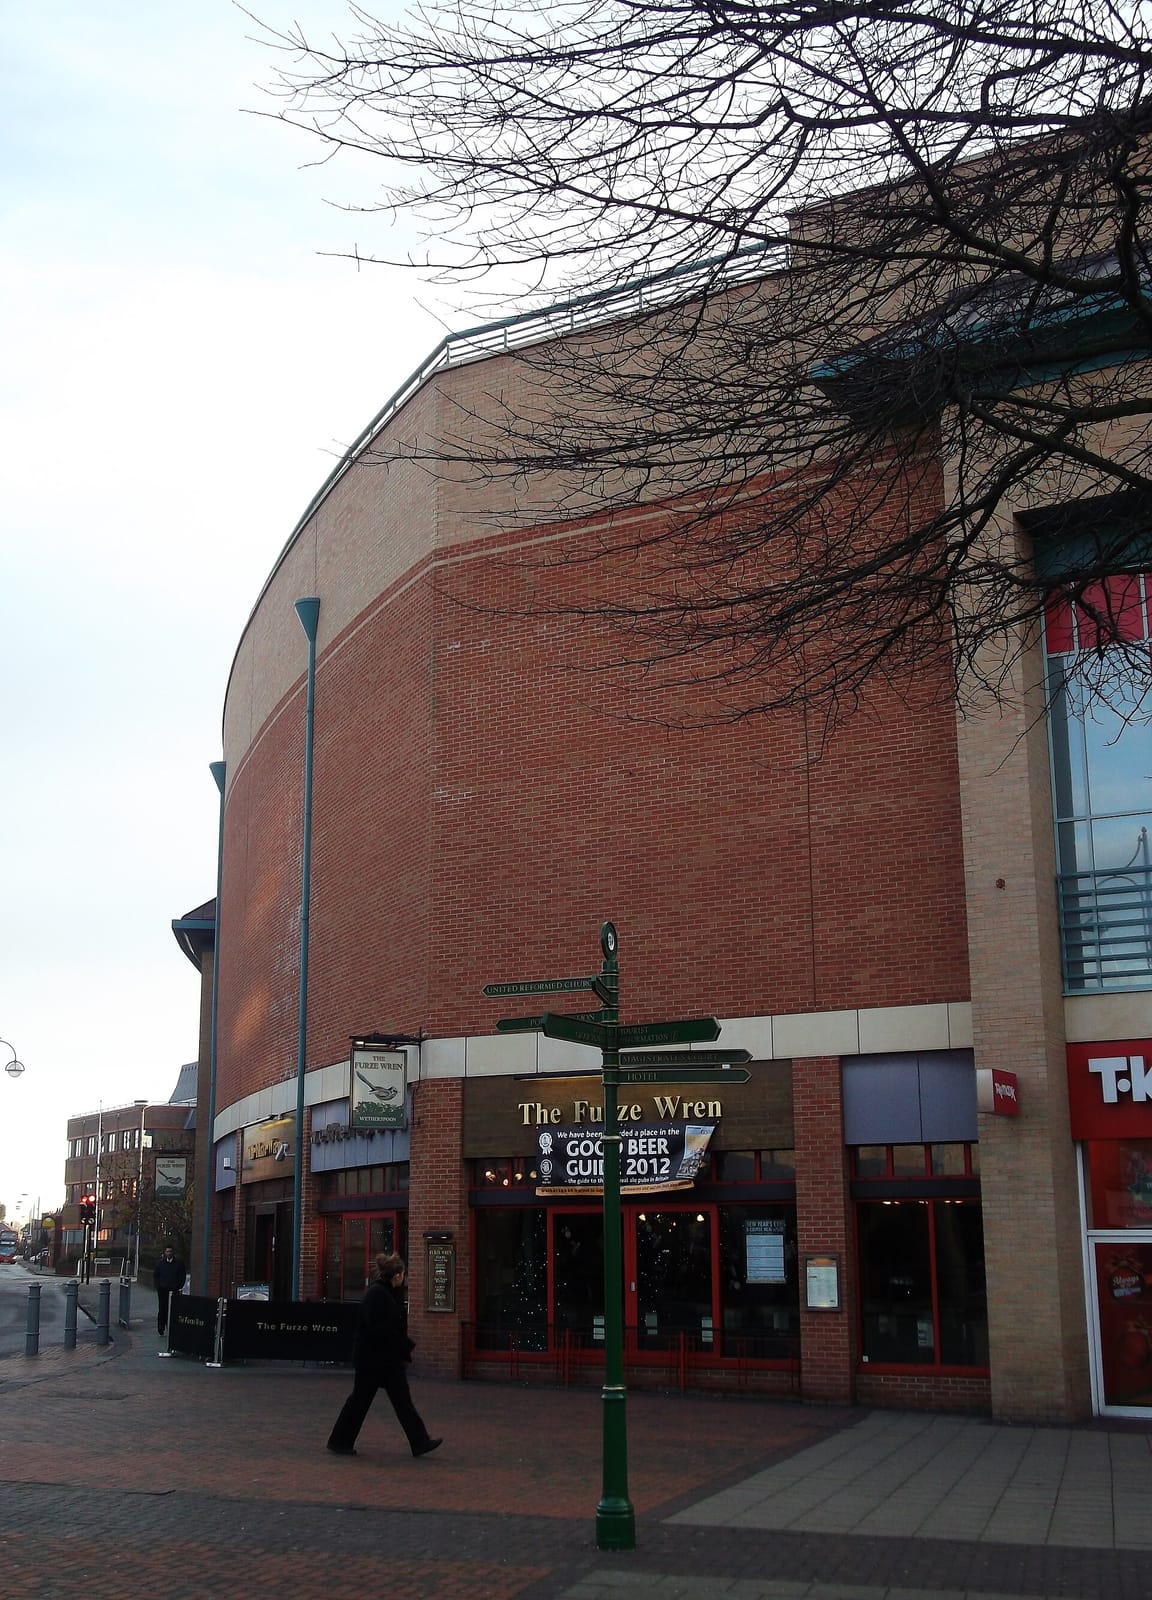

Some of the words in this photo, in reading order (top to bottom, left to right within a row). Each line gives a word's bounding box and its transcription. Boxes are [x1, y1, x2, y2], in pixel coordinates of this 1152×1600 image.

[486, 984, 518, 993] UNITED
[519, 982, 563, 992] REFORMED
[565, 979, 592, 989] CHURC
[627, 1072, 657, 1081] HOTEL
[518, 1103, 561, 1125] The
[573, 1100, 642, 1123] Fuze
[653, 1096, 722, 1119] Wren
[557, 1131, 568, 1139] We
[569, 1131, 585, 1139] have
[586, 1130, 603, 1139] been
[639, 1128, 659, 1138] place
[667, 1127, 680, 1135] the
[566, 1139, 623, 1157] GOO
[628, 1137, 669, 1155] BEER
[627, 1157, 670, 1175] 2012
[577, 1178, 590, 1186] guide
[257, 1322, 276, 1330] The
[280, 1323, 308, 1332] Furze
[312, 1324, 338, 1332] Wren
